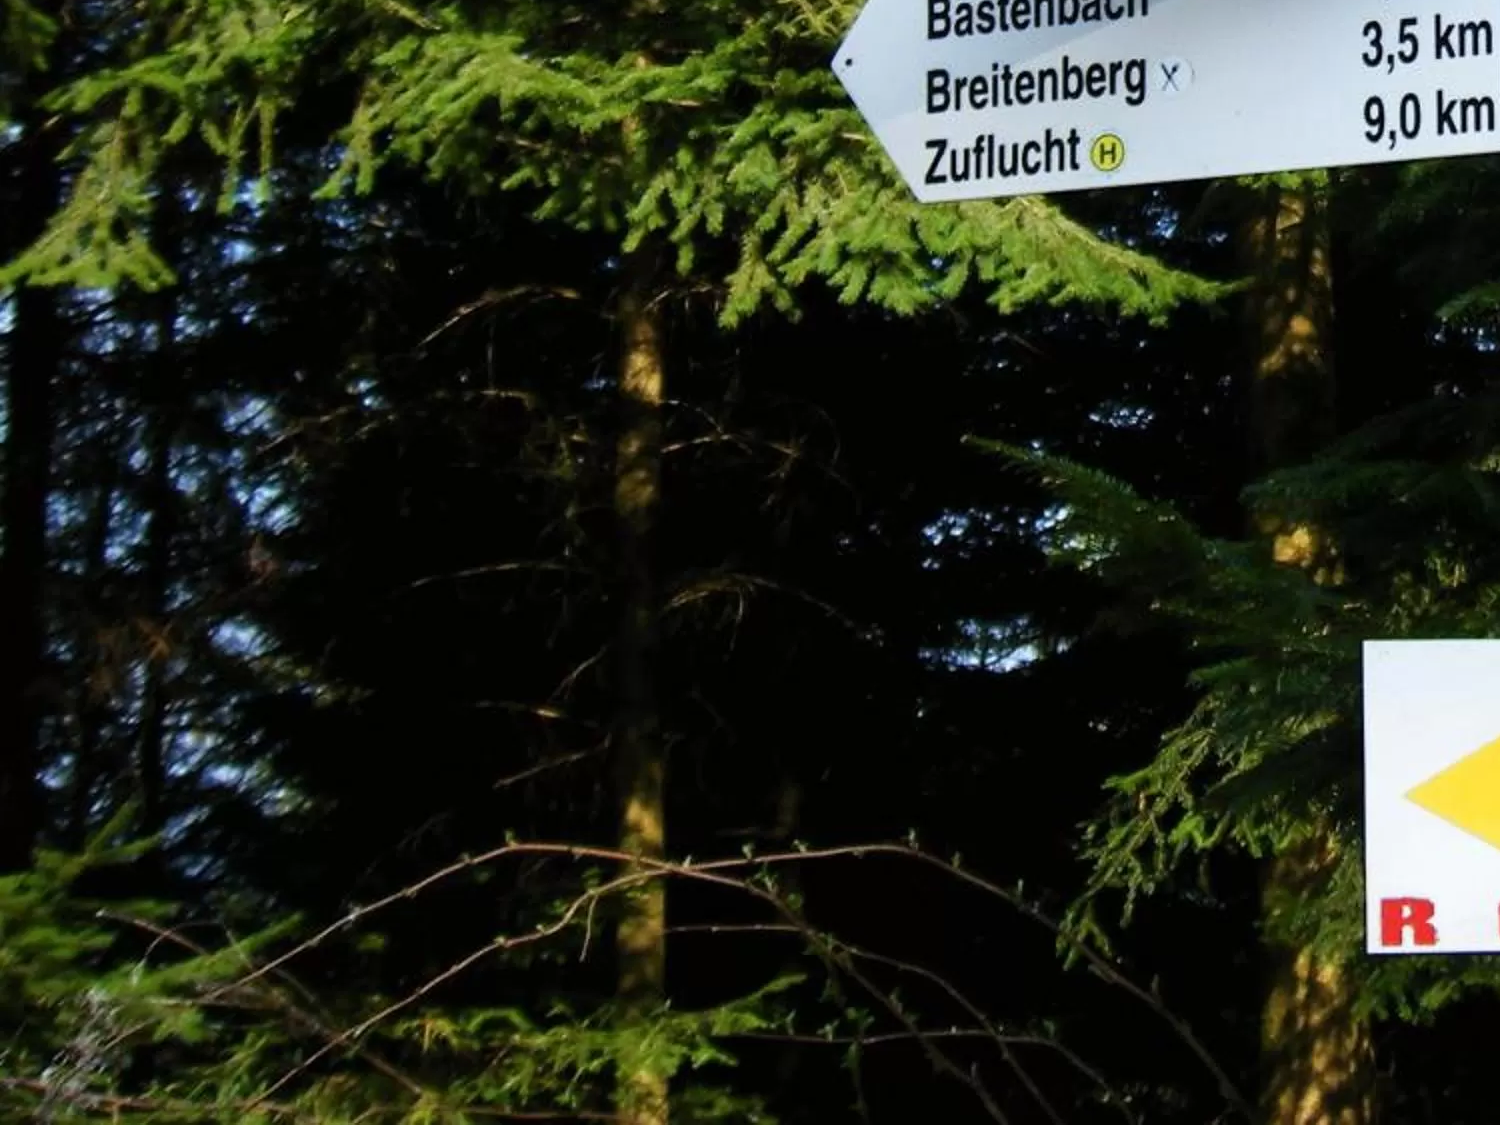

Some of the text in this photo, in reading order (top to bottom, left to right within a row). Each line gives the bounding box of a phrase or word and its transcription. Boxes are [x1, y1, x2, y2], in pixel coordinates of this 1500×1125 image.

[927, 14, 1492, 114] Breitenberg 3,5 km
[925, 129, 1080, 184] Zuflucht
[1364, 93, 1421, 149] 9,0
[1437, 90, 1494, 135] km
[1380, 897, 1438, 946] R
